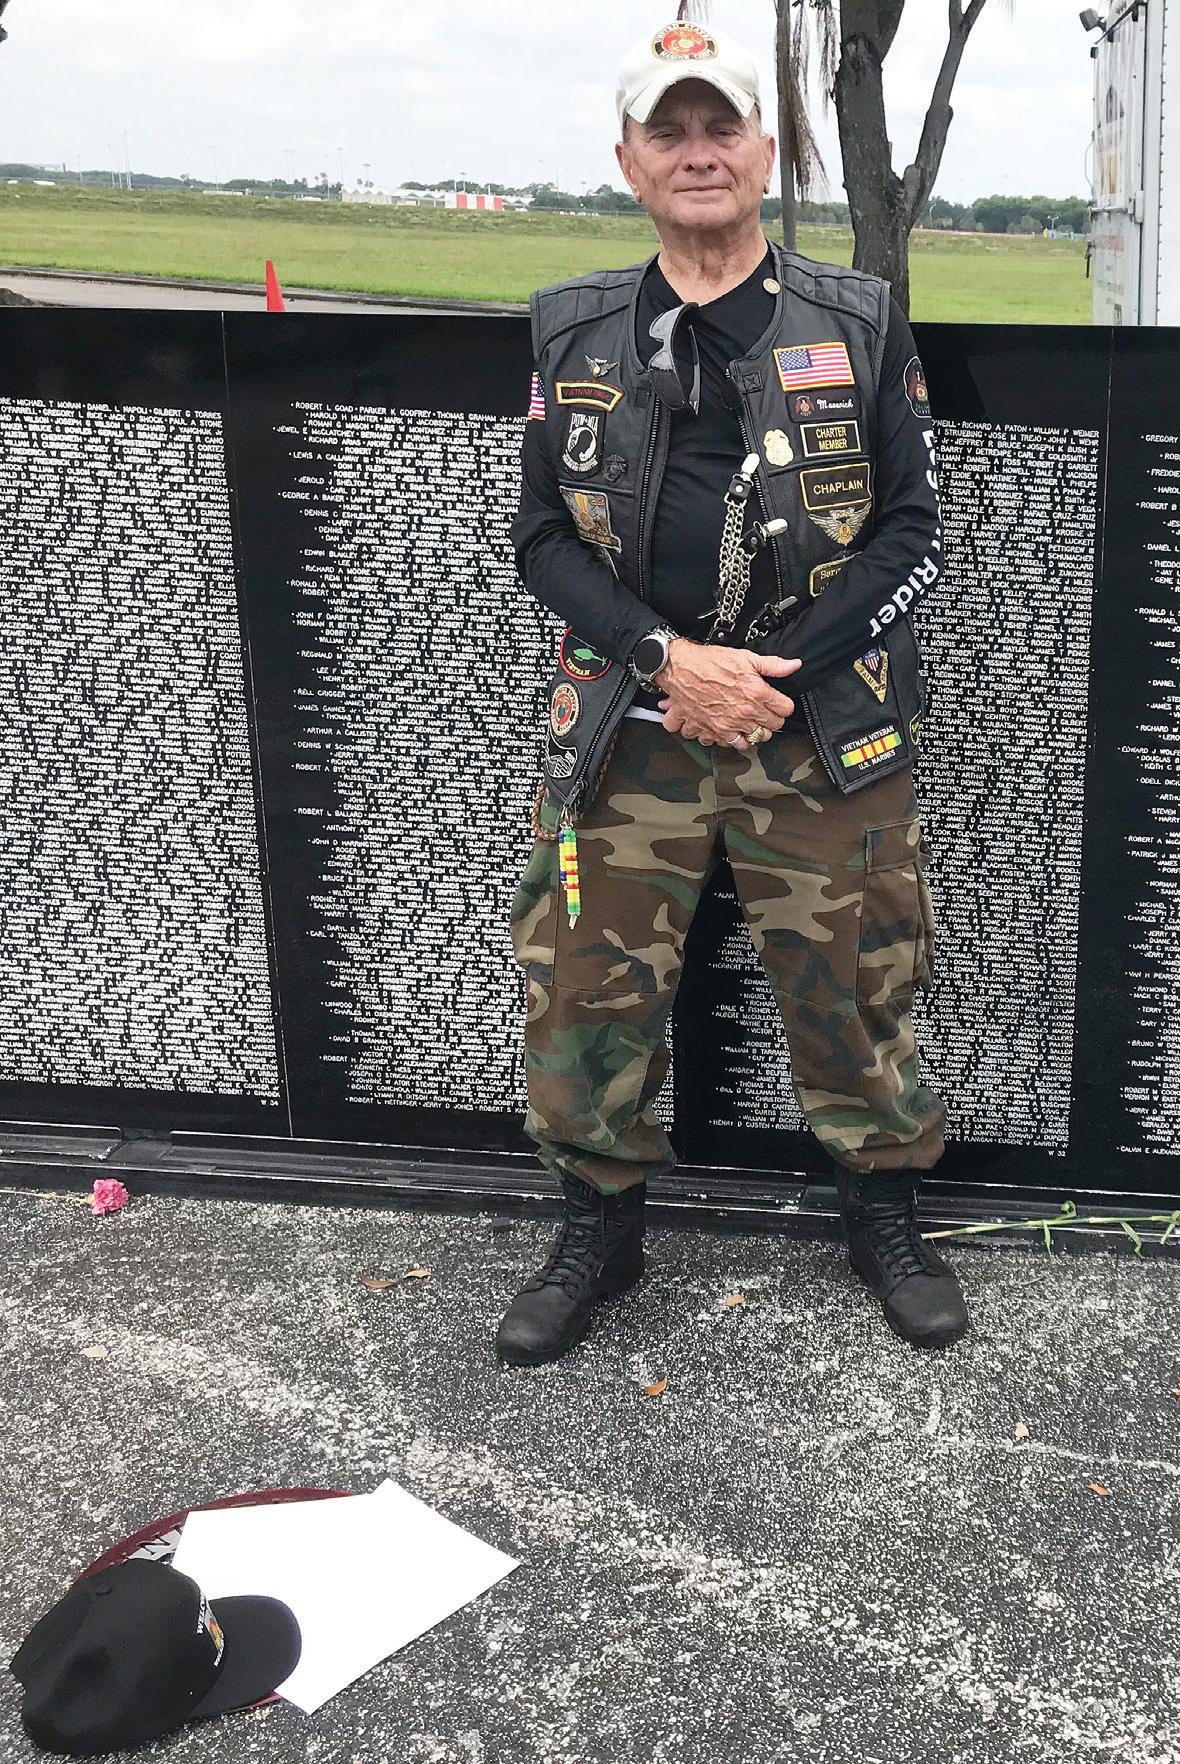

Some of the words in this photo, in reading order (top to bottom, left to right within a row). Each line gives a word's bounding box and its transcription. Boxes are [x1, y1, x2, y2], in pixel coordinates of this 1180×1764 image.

[87, 404, 111, 412] DANIEL
[123, 406, 147, 414] NAPOLI
[154, 408, 181, 417] GILBERT
[195, 411, 221, 419] TORRES
[296, 402, 322, 411] ROBERT
[335, 405, 353, 413] GOAD
[360, 406, 386, 415] PARKER
[400, 409, 431, 418] GODFREY
[437, 412, 464, 420] THOMAS
[469, 414, 496, 423] GRAHAM
[816, 426, 847, 438] CHARTER
[962, 421, 991, 430] RICHARD
[1005, 424, 1027, 432] PATON
[1034, 426, 1059, 435] WILLIAM
[818, 440, 848, 450] MEMBER
[989, 432, 1006, 440] JOSE
[1021, 434, 1041, 442] TREJO
[1048, 436, 1066, 444] JOHN
[1080, 439, 1098, 447] WEHR
[813, 479, 863, 494] CHAPLAIN
[870, 556, 938, 637] Rider
[841, 736, 868, 752] VIETNAM
[868, 725, 894, 742] VETERAN
[858, 760, 871, 770] U.S.
[872, 750, 896, 765] MARINES
